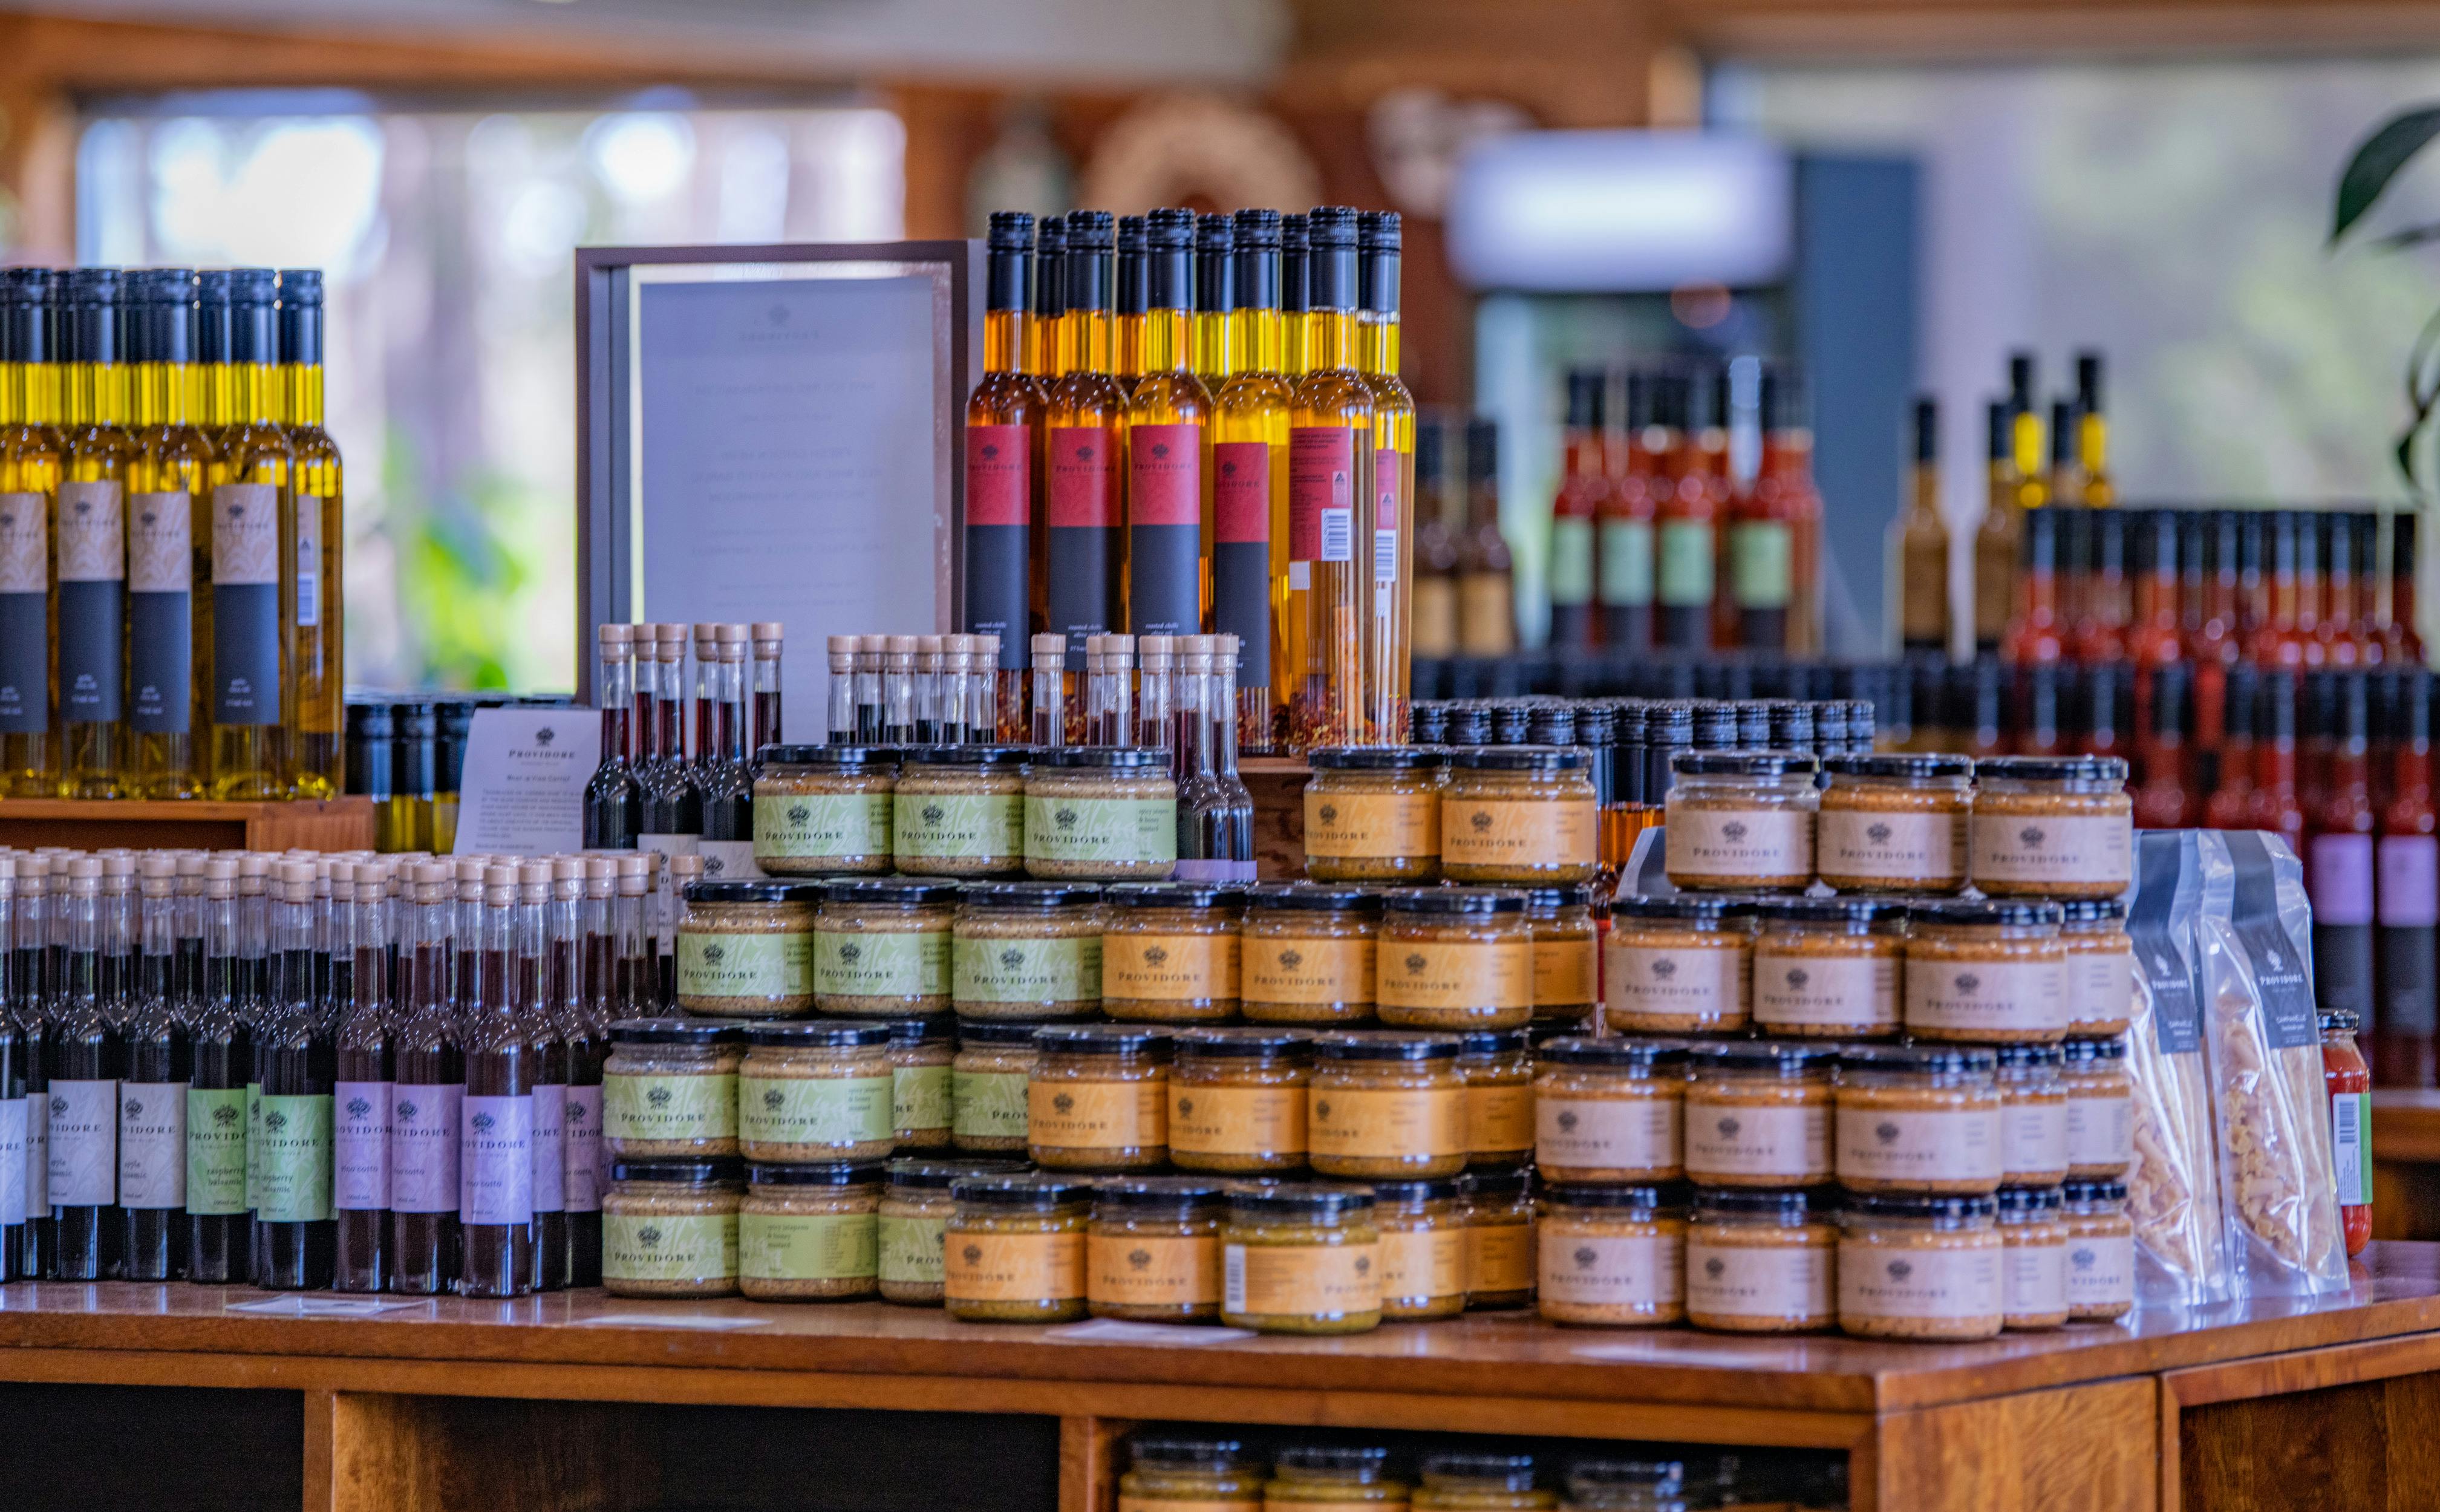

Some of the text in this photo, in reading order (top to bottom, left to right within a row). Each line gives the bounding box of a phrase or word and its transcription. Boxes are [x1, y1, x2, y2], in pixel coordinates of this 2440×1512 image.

[509, 750, 575, 758] PROVIDORE
[765, 832, 843, 841] PROVIDORE
[902, 830, 977, 841] PROVIDORE
[1033, 833, 1110, 844] PROVIDORE
[1451, 837, 1525, 847] PROVIDORE
[1694, 847, 1781, 858] PROVIDORE
[1839, 849, 1926, 861] PROVIDORE
[1991, 853, 2080, 865] PROVIDORE
[684, 968, 757, 979] PROVIDORE
[820, 968, 893, 979] PROVIDORE
[1118, 971, 1201, 982] PROVIDORE
[974, 975, 1059, 985] PROVIDORE
[1254, 975, 1336, 986] PROVIDORE
[1625, 985, 1711, 996] PROVIDORE
[1926, 999, 2016, 1011] PROVIDORE
[621, 1112, 706, 1123] PROVIDORE
[745, 1114, 818, 1125] PROVIDORE
[1032, 1119, 1107, 1130] PROVIDORE
[615, 1251, 695, 1262] PROVIDORE
[1102, 1276, 1187, 1287] PROVIDORE
